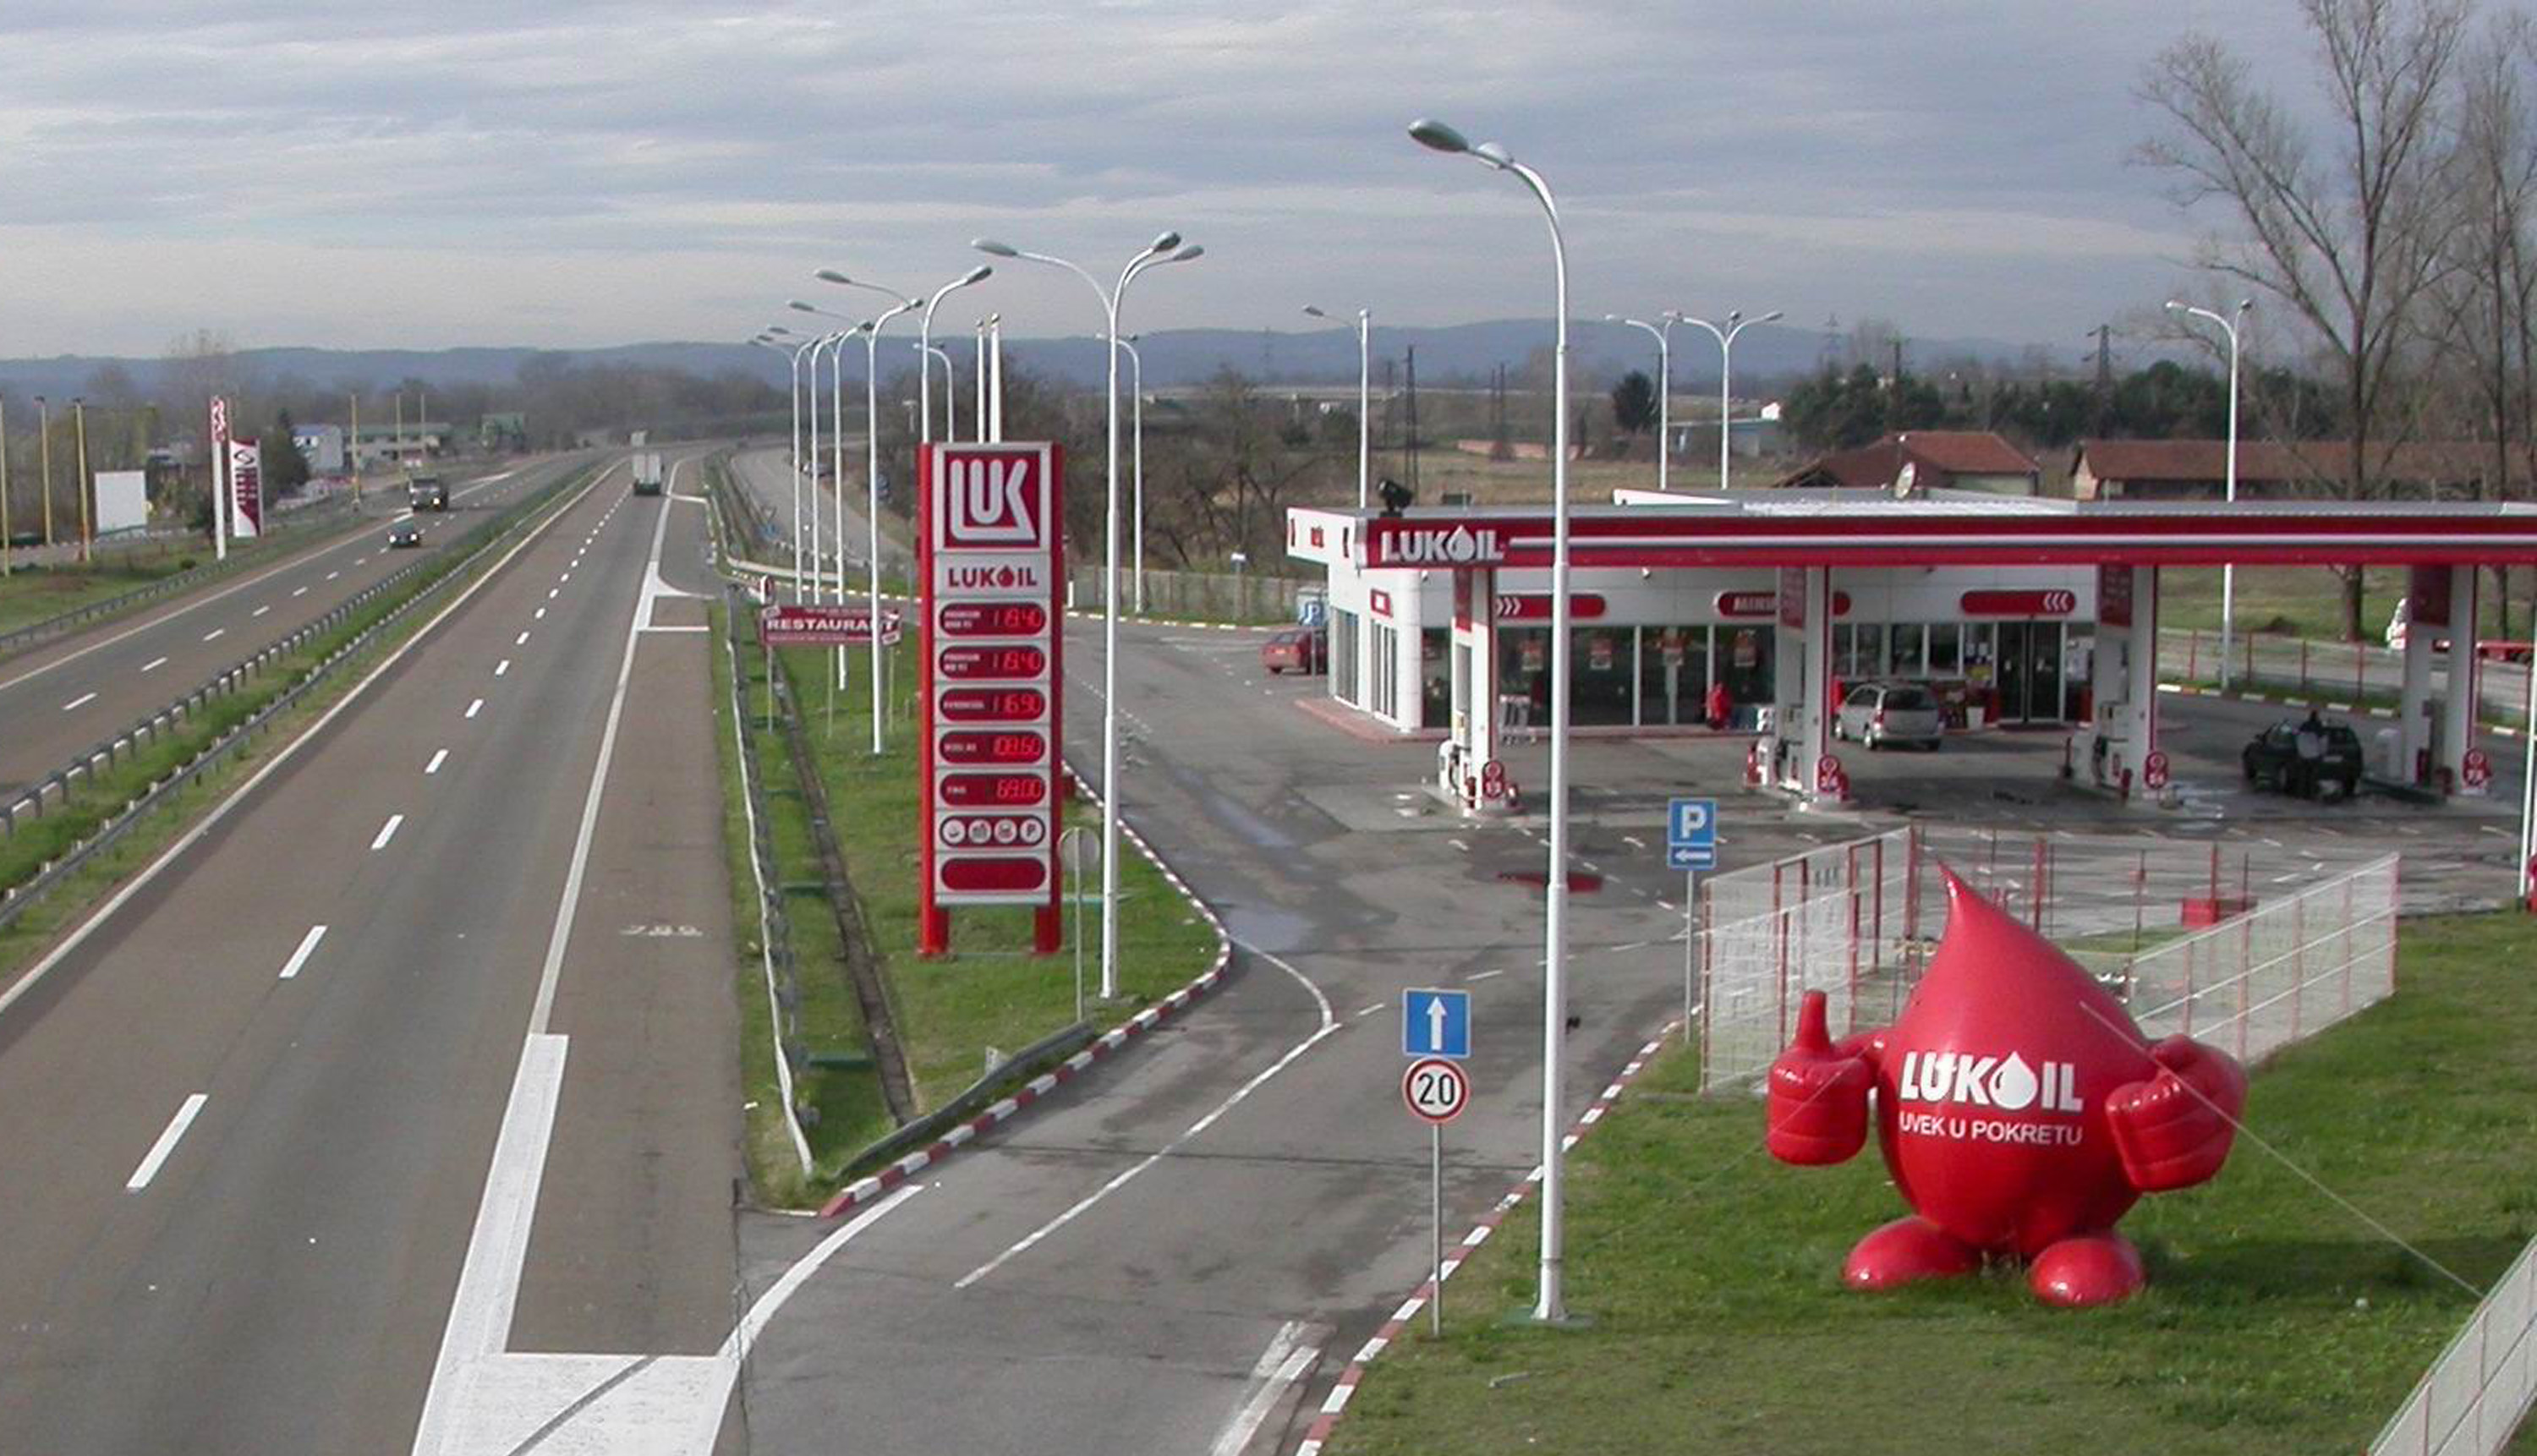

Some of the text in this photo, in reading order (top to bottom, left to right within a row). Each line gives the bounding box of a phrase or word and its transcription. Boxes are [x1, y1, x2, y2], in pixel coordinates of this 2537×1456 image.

[949, 459, 1037, 540] LUK
[1381, 525, 1504, 561] LUKOIL
[948, 565, 1037, 587] LUKOIL
[767, 618, 893, 632] RESTAURAT
[1681, 805, 1707, 839] P
[1418, 1073, 1455, 1106] 20
[1900, 1051, 2084, 1113] LUKOIL
[1899, 1111, 2083, 1145] UVEK U POKRETU
